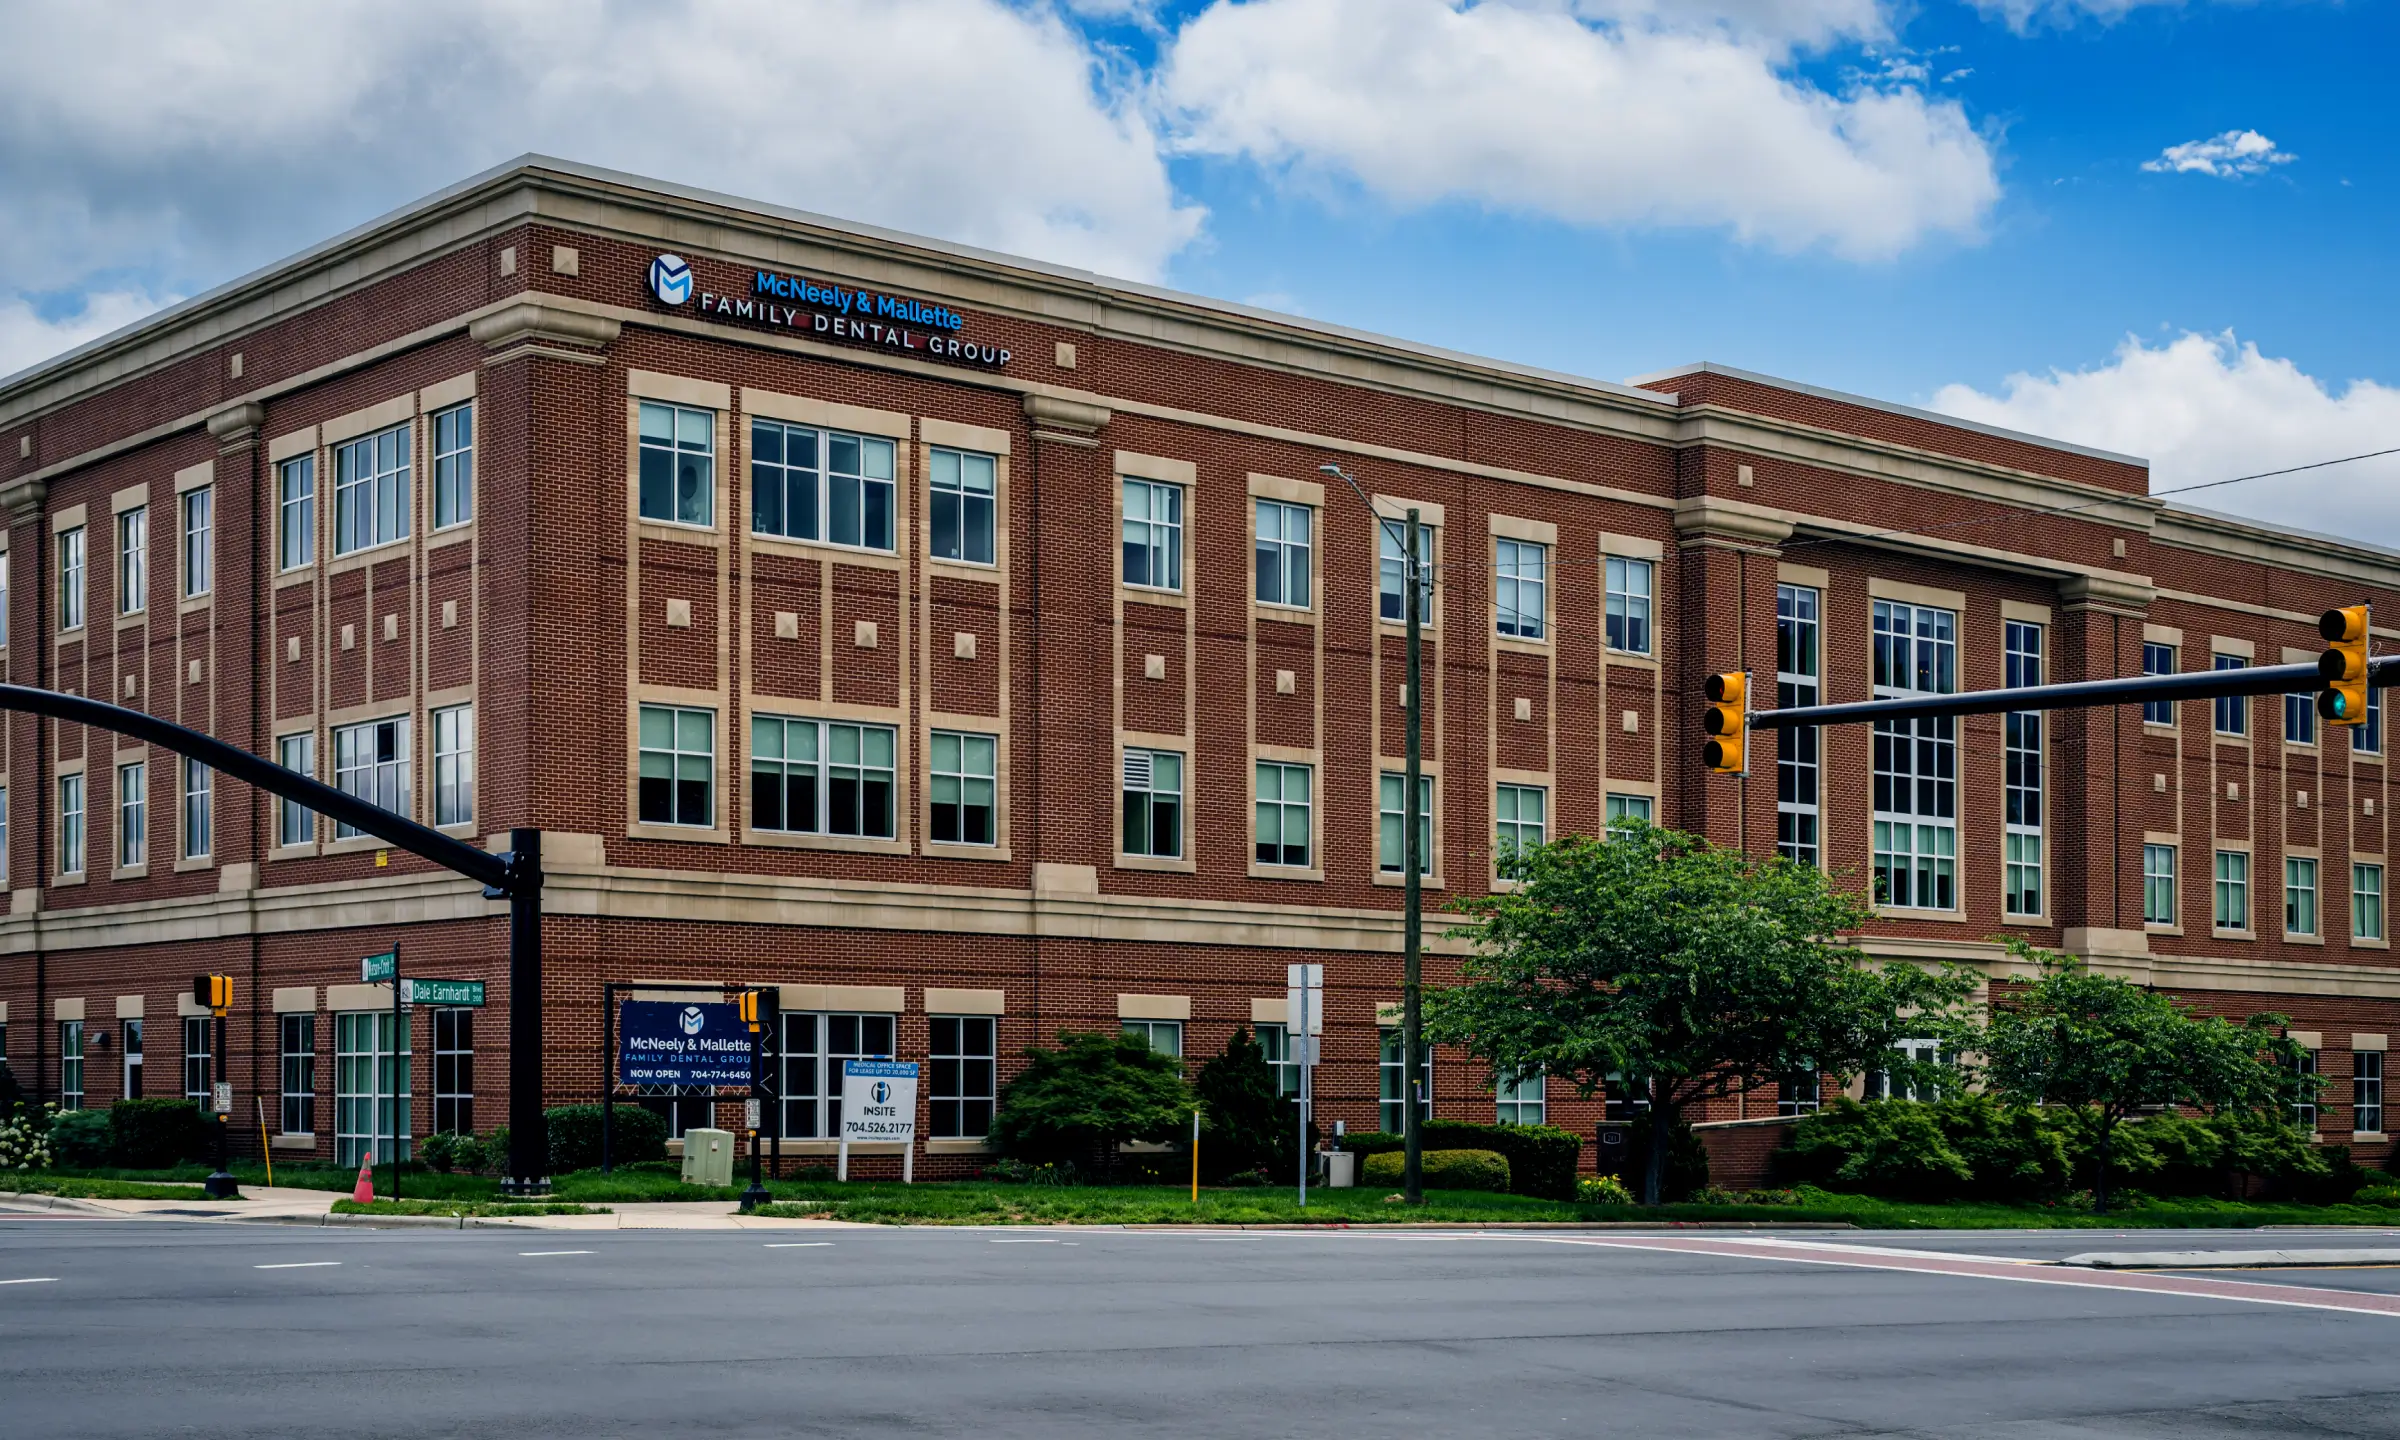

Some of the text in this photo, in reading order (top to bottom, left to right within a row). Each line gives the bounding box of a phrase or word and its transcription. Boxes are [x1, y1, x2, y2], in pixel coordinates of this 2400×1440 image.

[757, 271, 963, 330] McNeely & Mallette
[701, 293, 1011, 366] FAMILY DENTAL GROUP
[414, 983, 431, 1000] Dale
[433, 984, 470, 1002] Earnhardt
[630, 1037, 751, 1053] McNeely & Mallette
[625, 1053, 751, 1063] FAMILY DENTAL GROU
[630, 1069, 751, 1079] NOW OPEN 704-774-6450
[863, 1106, 896, 1116] INSITE
[846, 1122, 912, 1133] 704.526.2177
